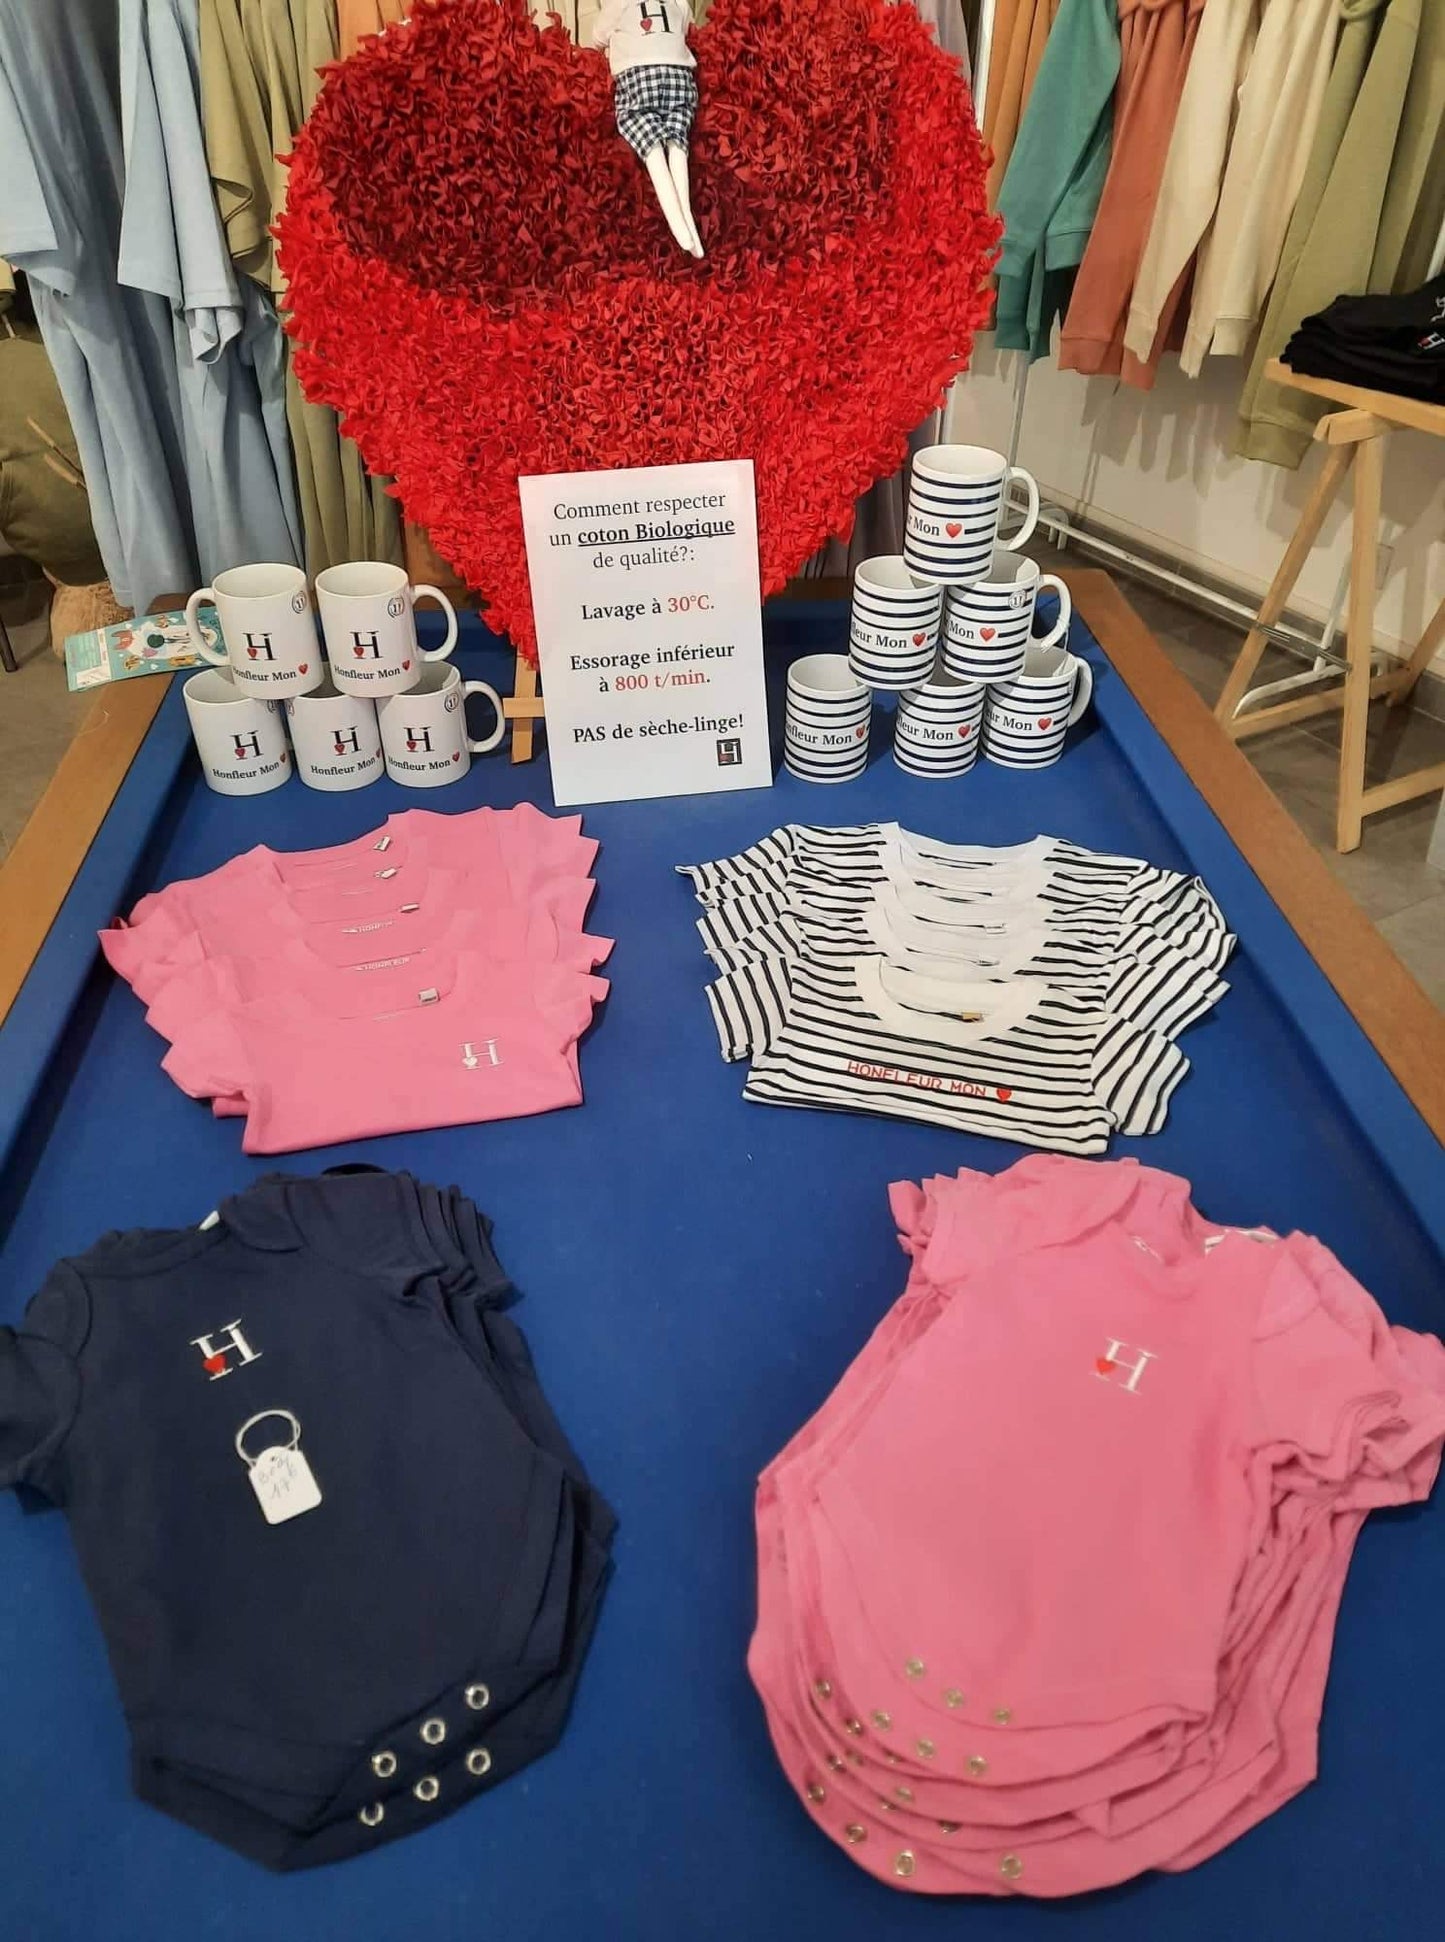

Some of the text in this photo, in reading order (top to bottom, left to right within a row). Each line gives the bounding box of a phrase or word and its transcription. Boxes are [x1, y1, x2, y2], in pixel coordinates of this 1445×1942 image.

[554, 494, 727, 520] Comment respecter
[550, 519, 736, 547] un coton Biologique
[593, 546, 695, 571] de qualité?:
[581, 595, 715, 621] Lavage à 30°C.
[876, 634, 907, 648] Mon
[950, 621, 974, 639] Mon
[242, 632, 278, 660] H
[349, 630, 384, 659] H
[570, 643, 736, 671] Essorage inférieur
[272, 671, 297, 681] Mon
[377, 667, 400, 679] Mon
[599, 670, 711, 693] à 800 t/min.
[573, 713, 744, 743] PAS de sèche-linge!
[923, 728, 953, 740] Mon
[1003, 715, 1032, 731] Mon
[230, 730, 264, 760] H
[331, 726, 361, 756] H
[403, 726, 435, 753] H
[823, 735, 851, 745] Mon
[212, 761, 279, 779] Honfleur Mon
[311, 757, 376, 776] Honfleur Mon
[428, 760, 451, 770] Mon
[847, 1060, 987, 1098] HONFLEUR MON
[189, 1318, 263, 1381] H
[1088, 1336, 1159, 1395] H
